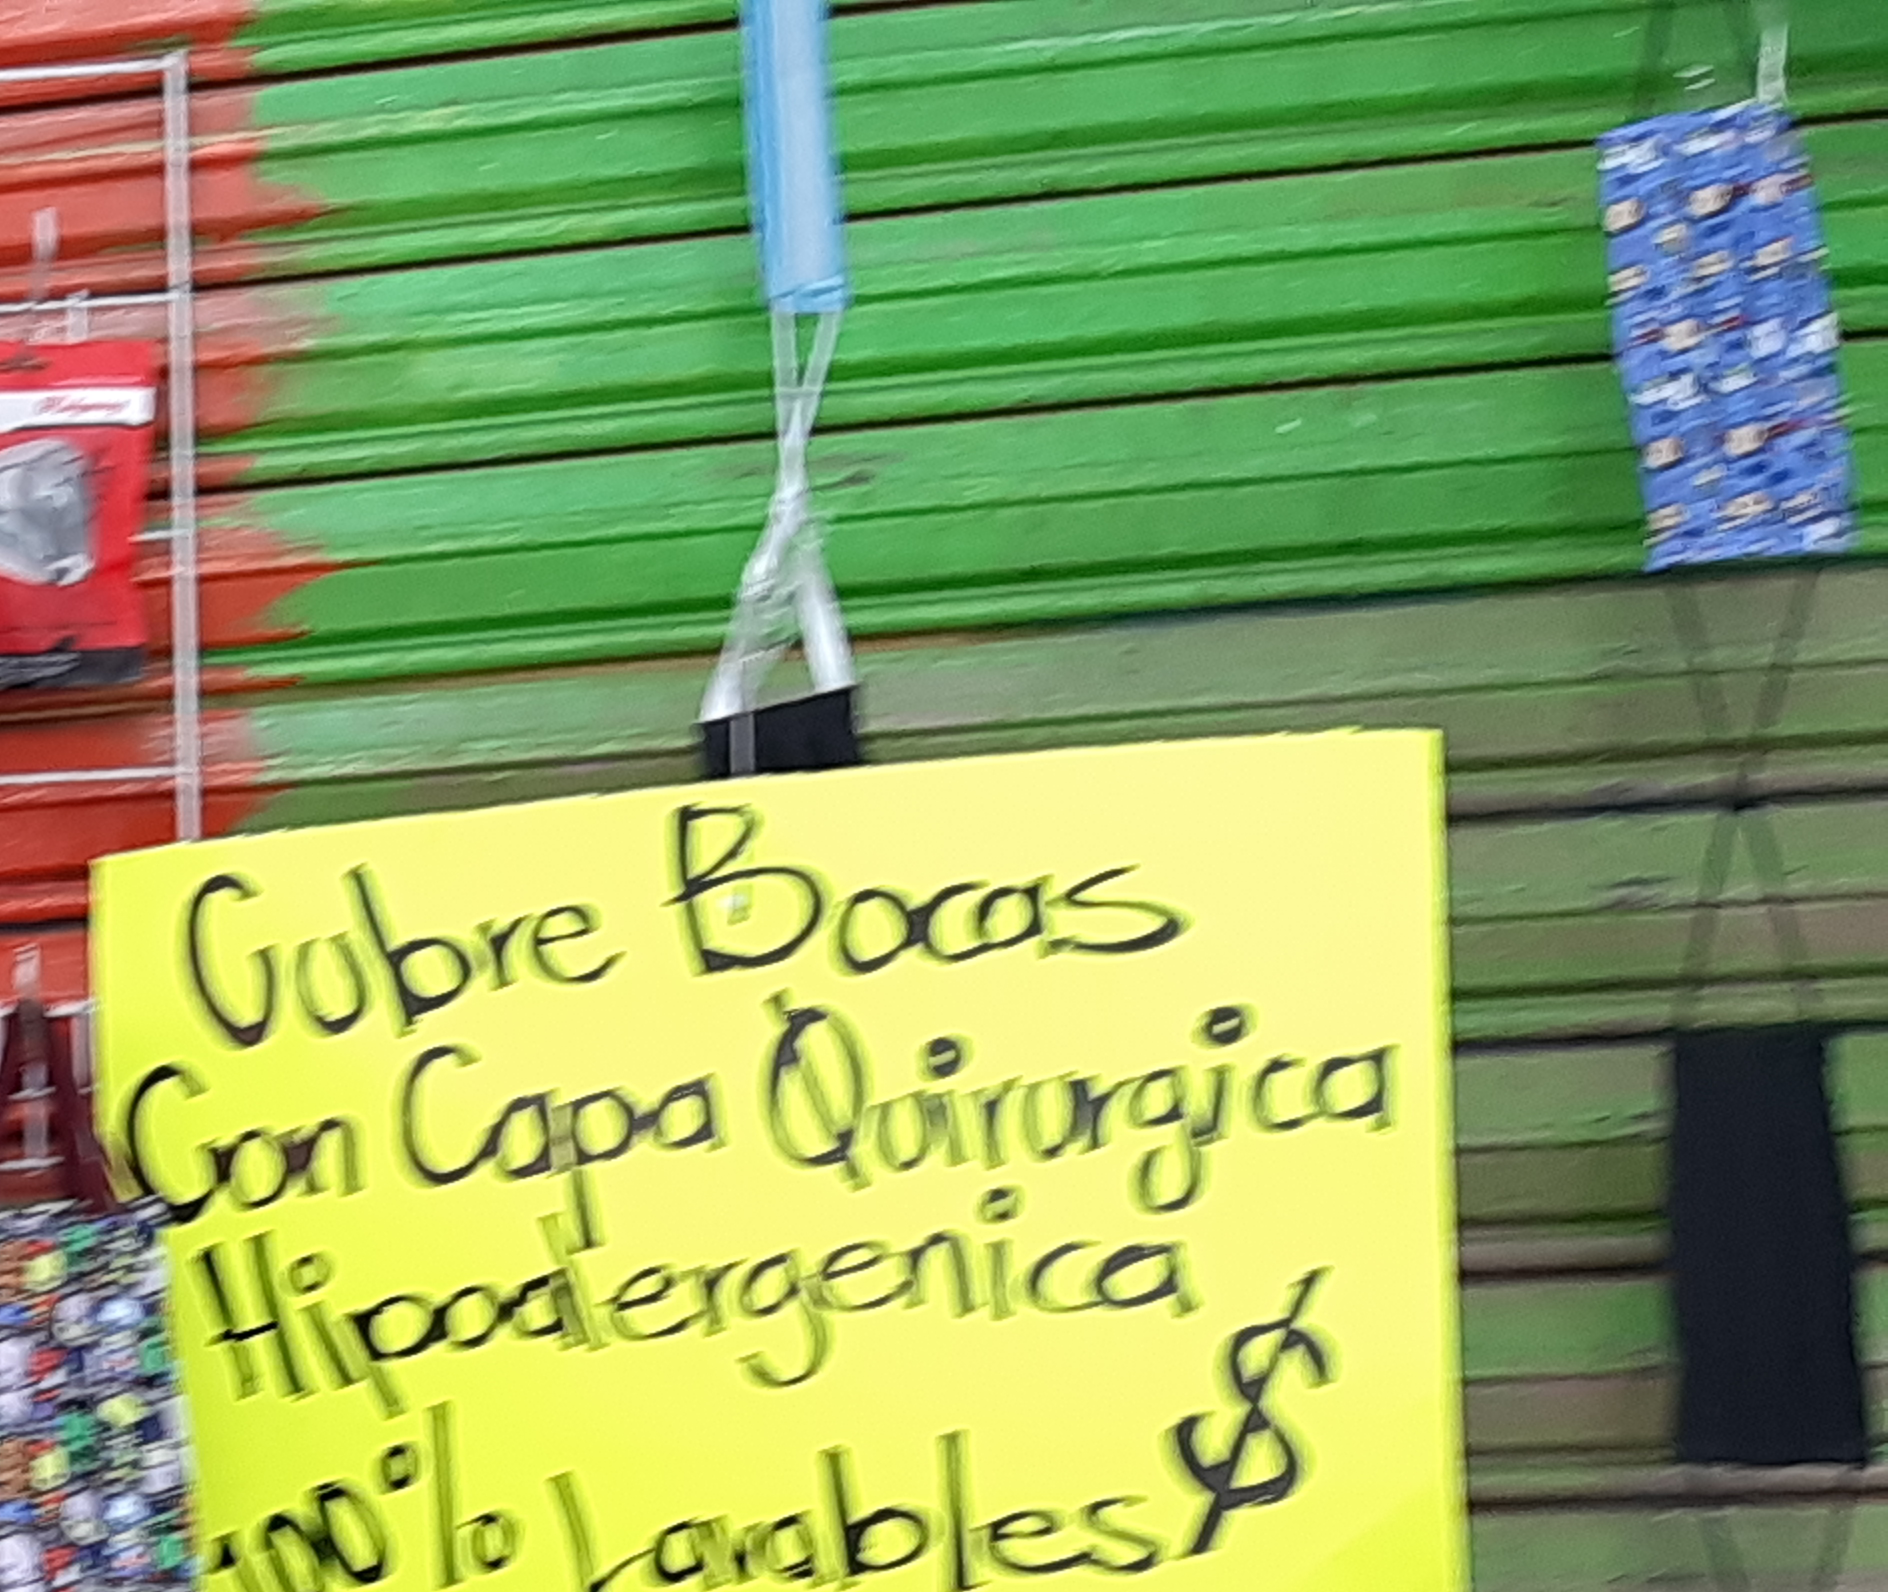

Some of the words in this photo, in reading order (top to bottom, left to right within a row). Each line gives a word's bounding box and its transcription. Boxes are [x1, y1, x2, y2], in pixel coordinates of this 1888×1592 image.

[179, 862, 626, 1048] Cubre
[662, 802, 1192, 976] Bocas
[116, 1062, 364, 1222] Con
[396, 1045, 729, 1250] Capa
[762, 988, 1400, 1213] Quirurgica
[189, 1187, 1204, 1420] Hipoalergenica
[1158, 1265, 1338, 1560] $
